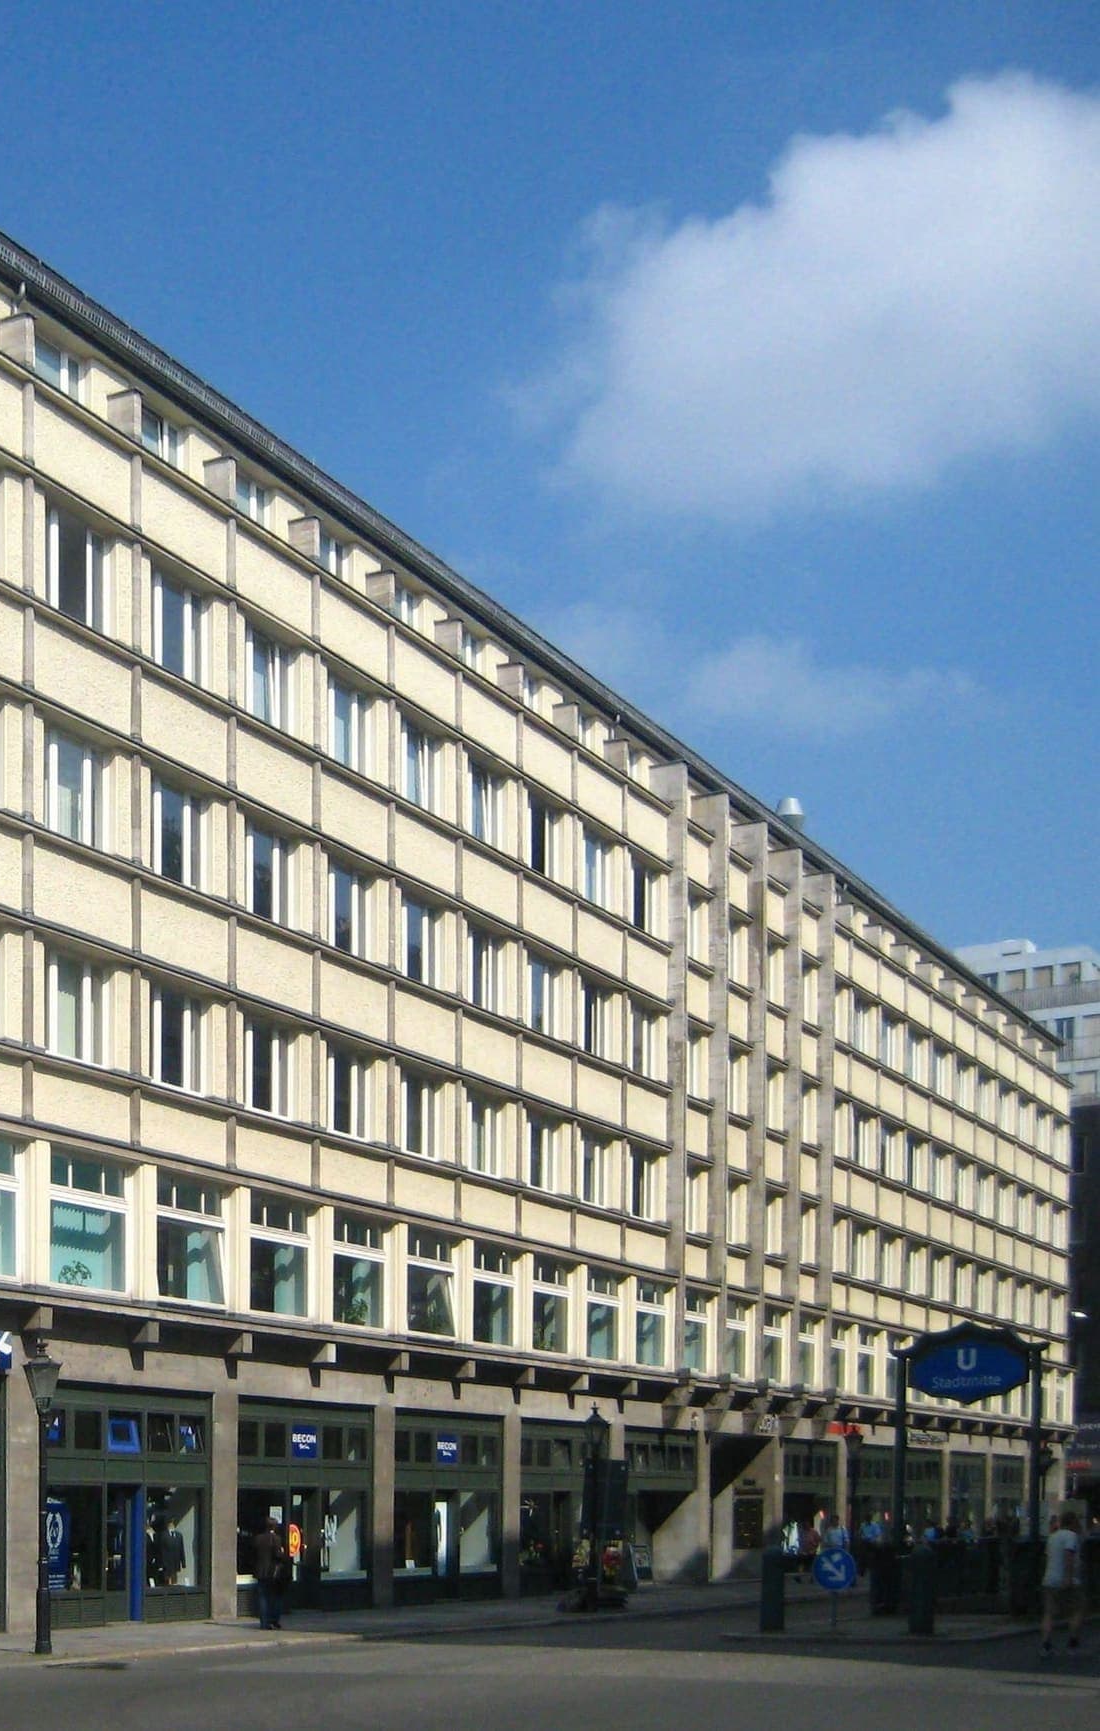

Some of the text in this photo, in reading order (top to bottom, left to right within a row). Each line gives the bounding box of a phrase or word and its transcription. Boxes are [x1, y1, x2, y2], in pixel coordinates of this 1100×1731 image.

[957, 1347, 977, 1371] U
[931, 1375, 1002, 1389] Stadtmitte
[292, 1433, 317, 1443] BECON
[437, 1441, 457, 1450] BECON
